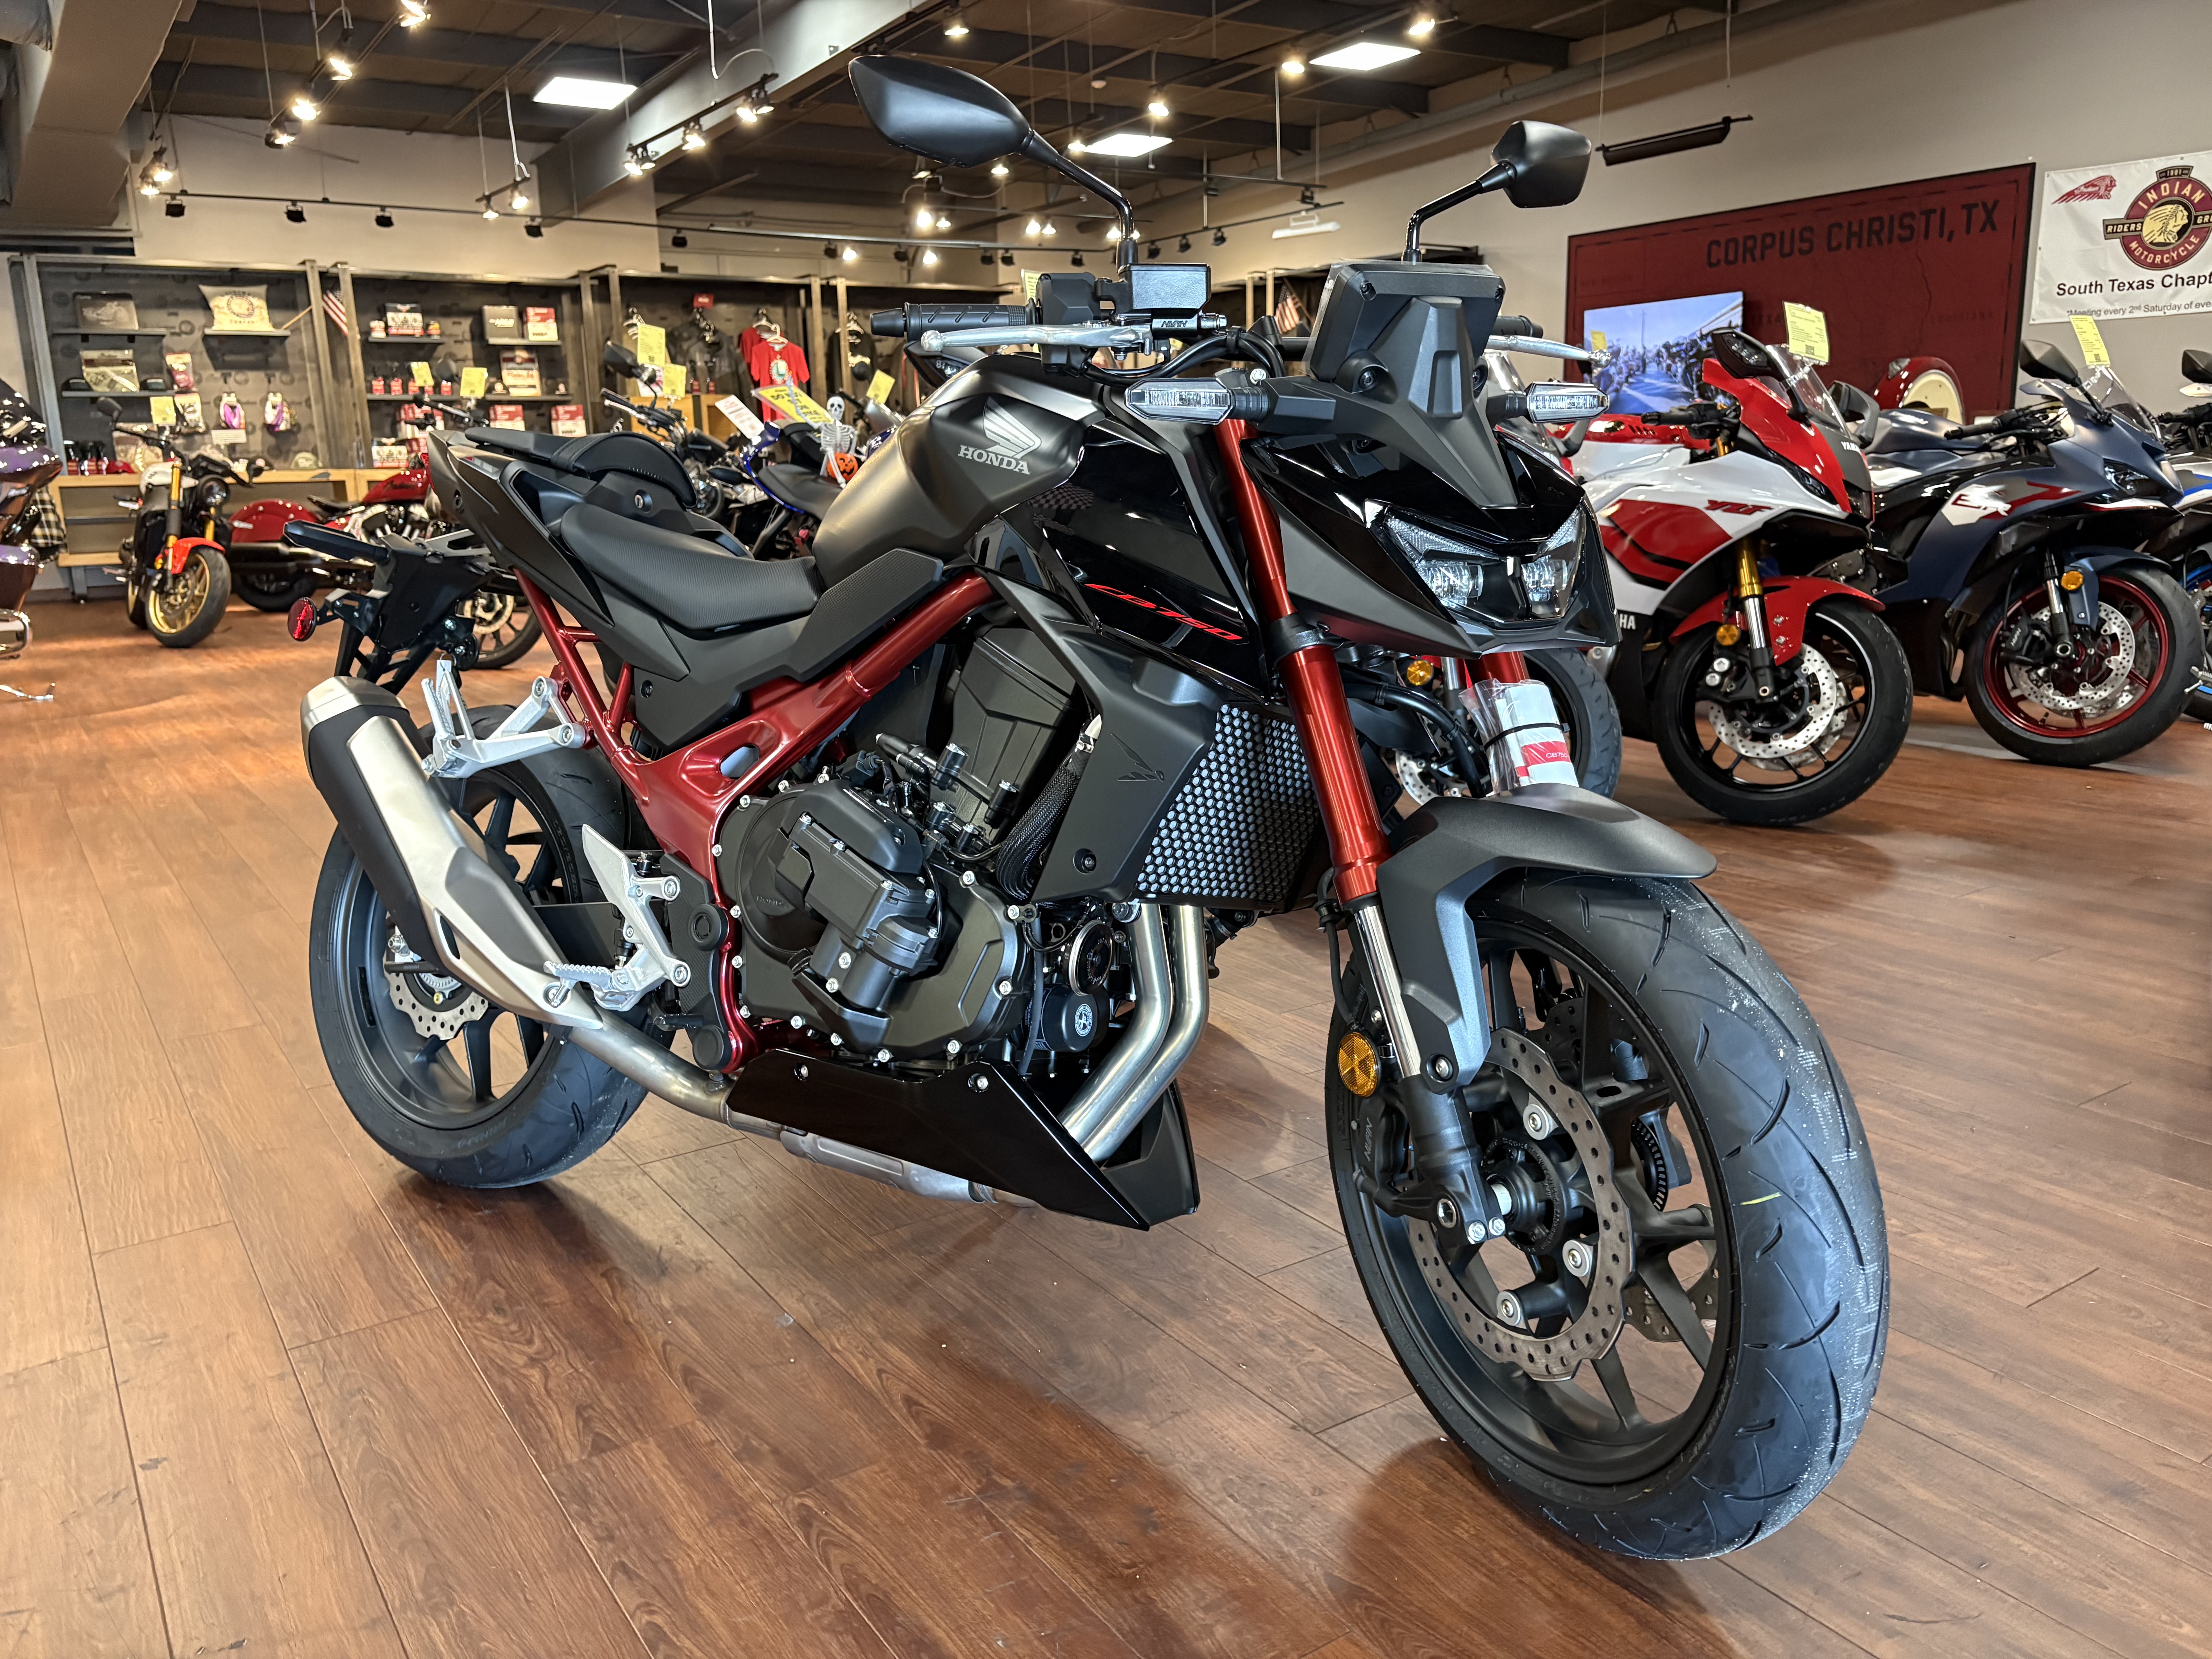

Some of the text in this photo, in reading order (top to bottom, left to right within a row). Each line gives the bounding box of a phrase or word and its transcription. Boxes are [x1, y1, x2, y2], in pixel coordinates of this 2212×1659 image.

[2138, 181, 2205, 209] INDIAN
[1707, 199, 1999, 268] CORPUS CHRISTI, TX
[2107, 223, 2143, 233] RIDERS
[2129, 235, 2200, 264] MOTORCYCLE
[2056, 280, 2103, 296] South
[2109, 278, 2155, 292] Texas
[2104, 307, 2126, 316] every
[2128, 305, 2142, 313] 2nd
[2143, 303, 2182, 313] Saturday
[2184, 301, 2193, 309] of
[958, 445, 1030, 475] HONDA
[1084, 584, 1243, 640] CB750
